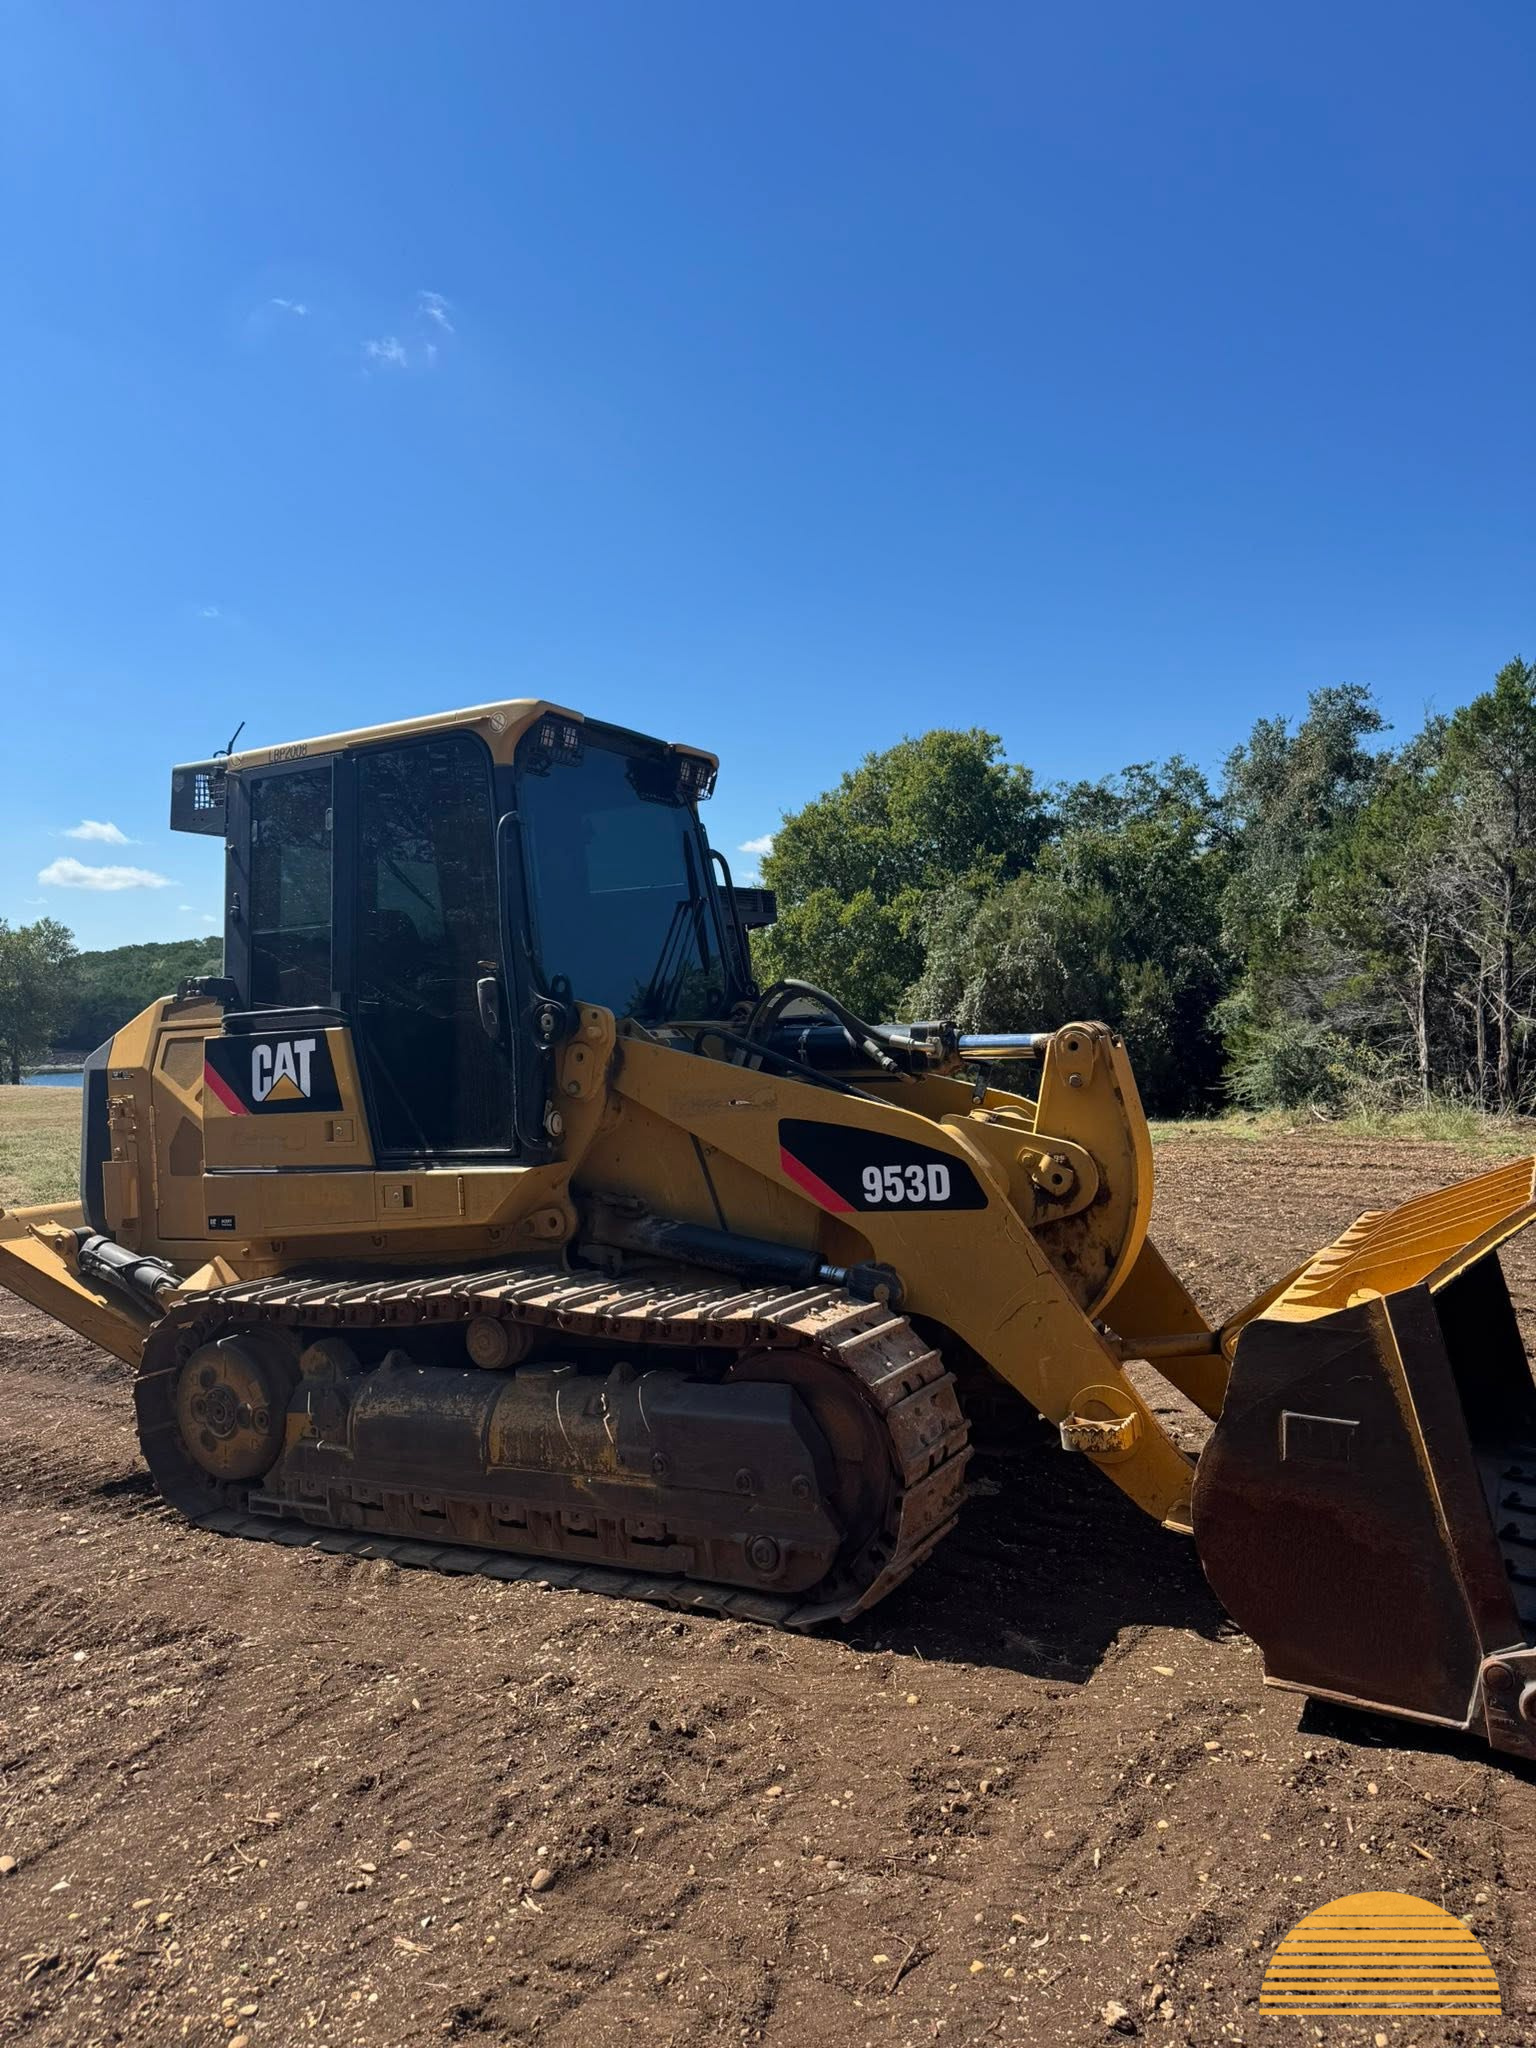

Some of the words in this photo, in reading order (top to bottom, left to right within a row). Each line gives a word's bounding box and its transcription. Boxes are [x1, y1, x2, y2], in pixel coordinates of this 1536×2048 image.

[268, 743, 308, 762] LBP2008
[251, 1038, 316, 1102] CAT
[862, 1164, 951, 1203] 953D
